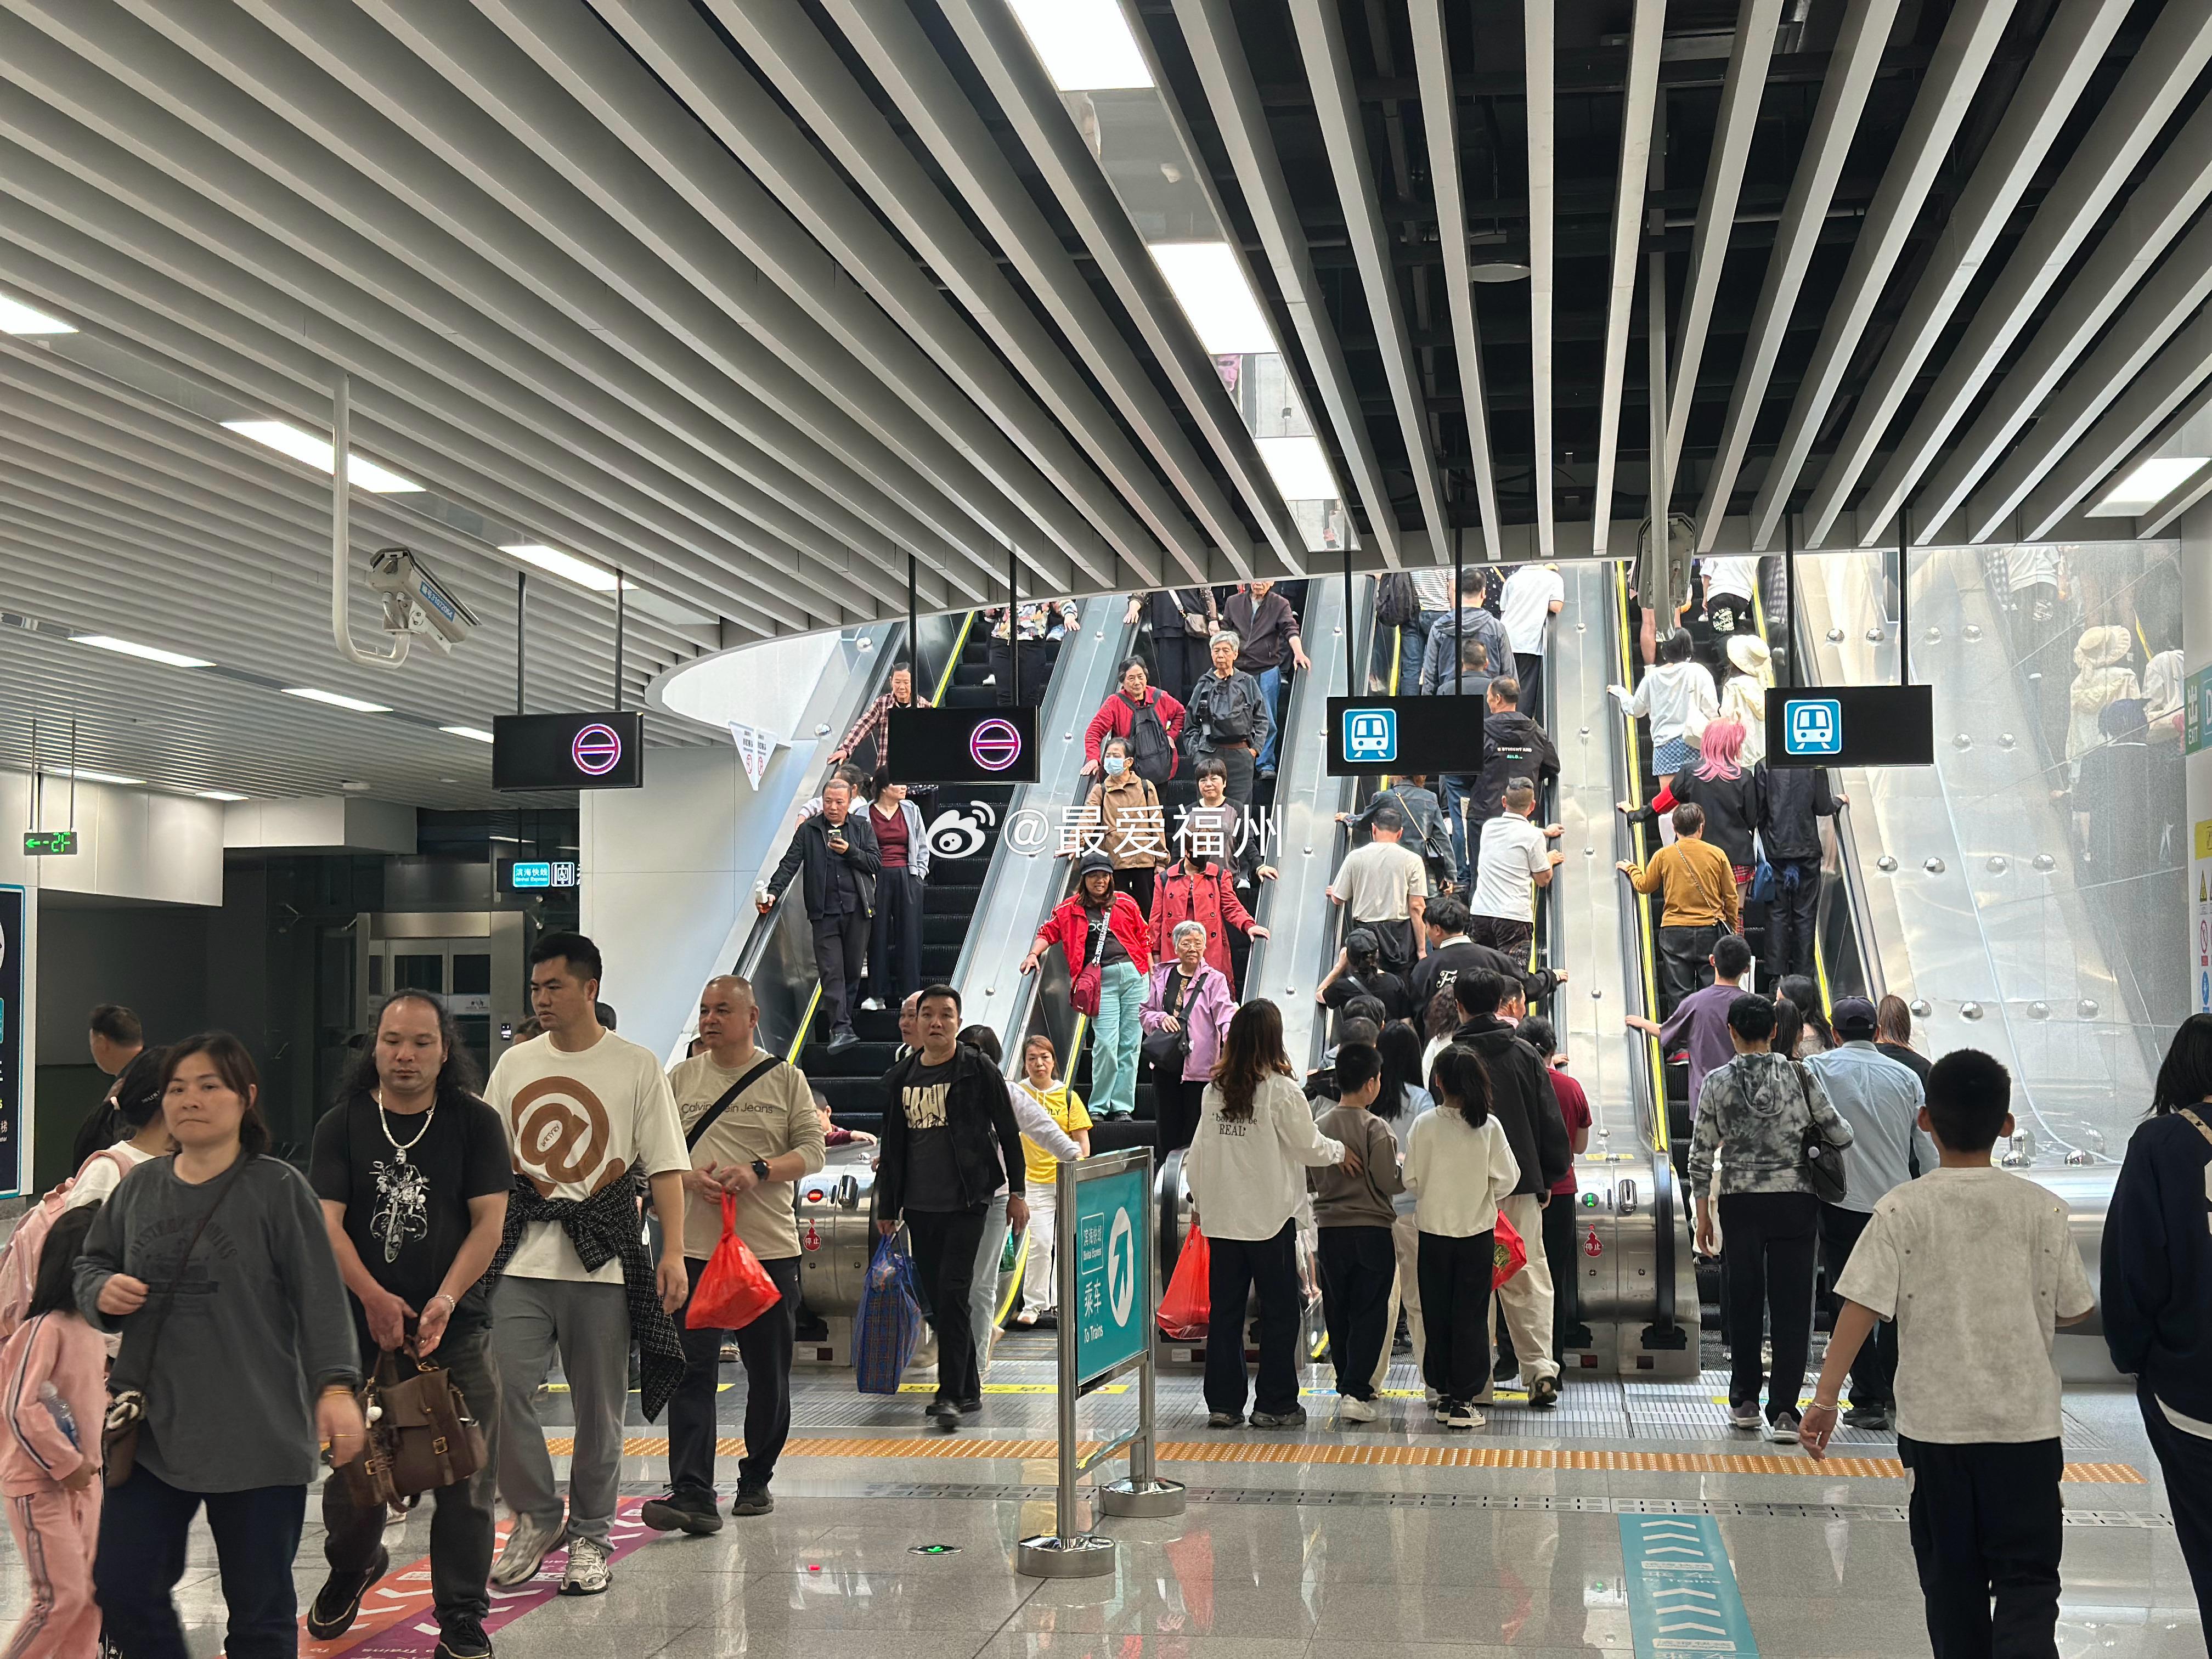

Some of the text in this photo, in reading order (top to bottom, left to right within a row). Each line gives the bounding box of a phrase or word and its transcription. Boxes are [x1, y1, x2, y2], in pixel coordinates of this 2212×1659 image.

[2188, 726, 2198, 744] EXIT
[741, 1102, 773, 1114] Jeans
[805, 1237, 820, 1246] 停止
[1084, 1278, 1102, 1318] 乘车
[1084, 1324, 1103, 1344] To Trains
